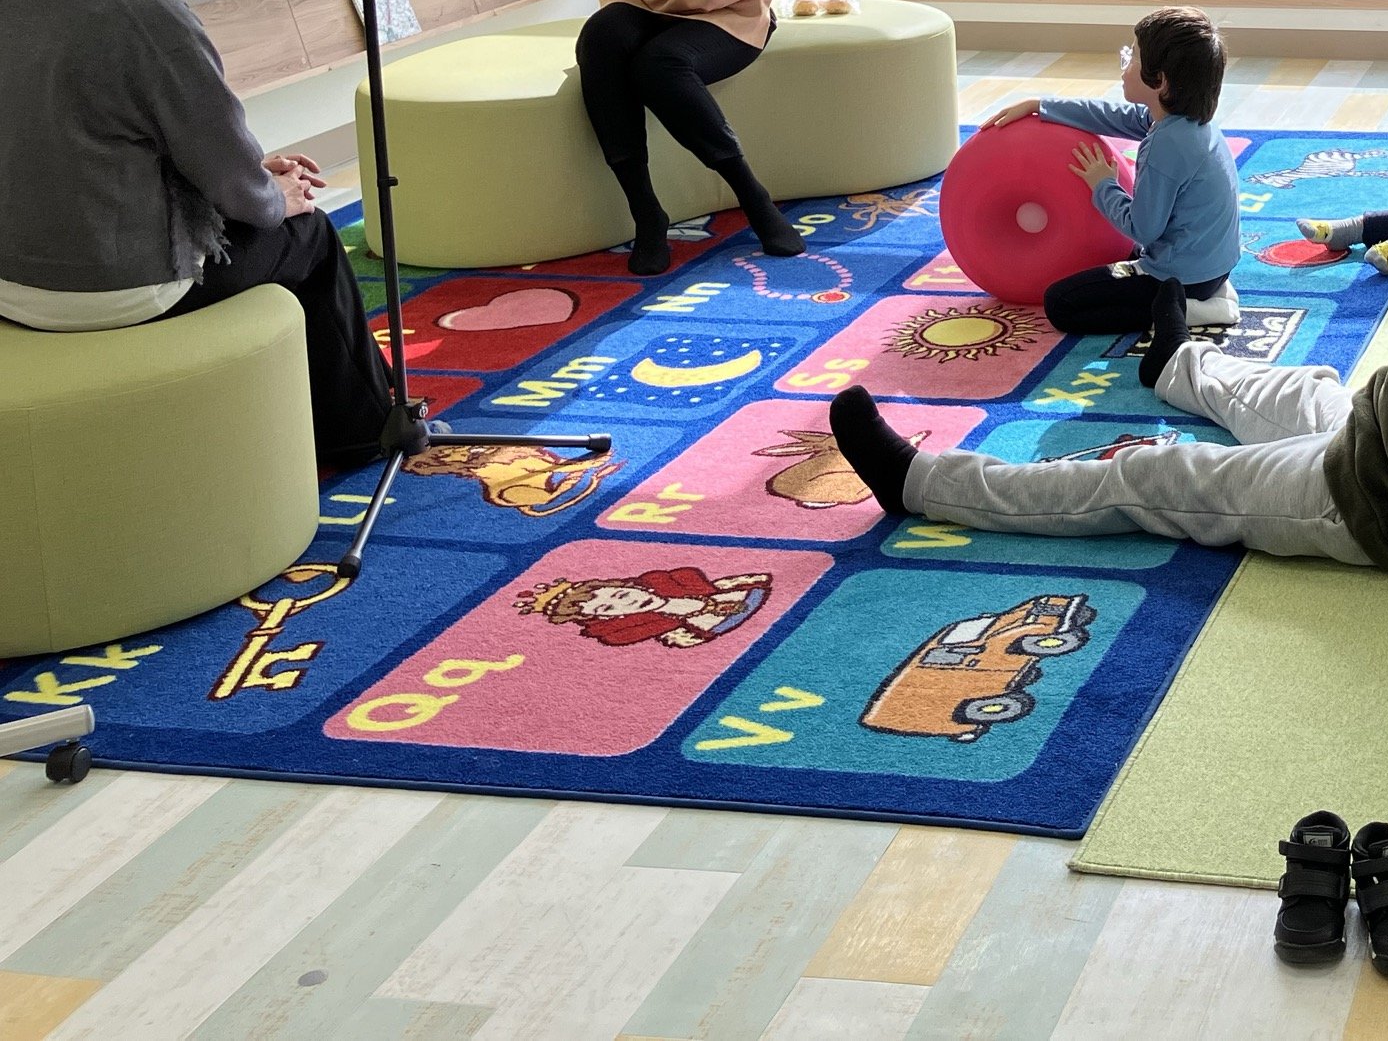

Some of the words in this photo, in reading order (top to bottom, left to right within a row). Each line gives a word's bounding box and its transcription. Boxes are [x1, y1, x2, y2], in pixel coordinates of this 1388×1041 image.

[640, 281, 731, 313] Nn
[491, 355, 618, 407] Mm
[787, 356, 870, 390] Ss
[1034, 371, 1122, 407] Xx
[607, 481, 706, 524] Rr
[3, 643, 163, 707] Kk
[344, 653, 526, 733] Qq
[695, 685, 826, 752] Vv
